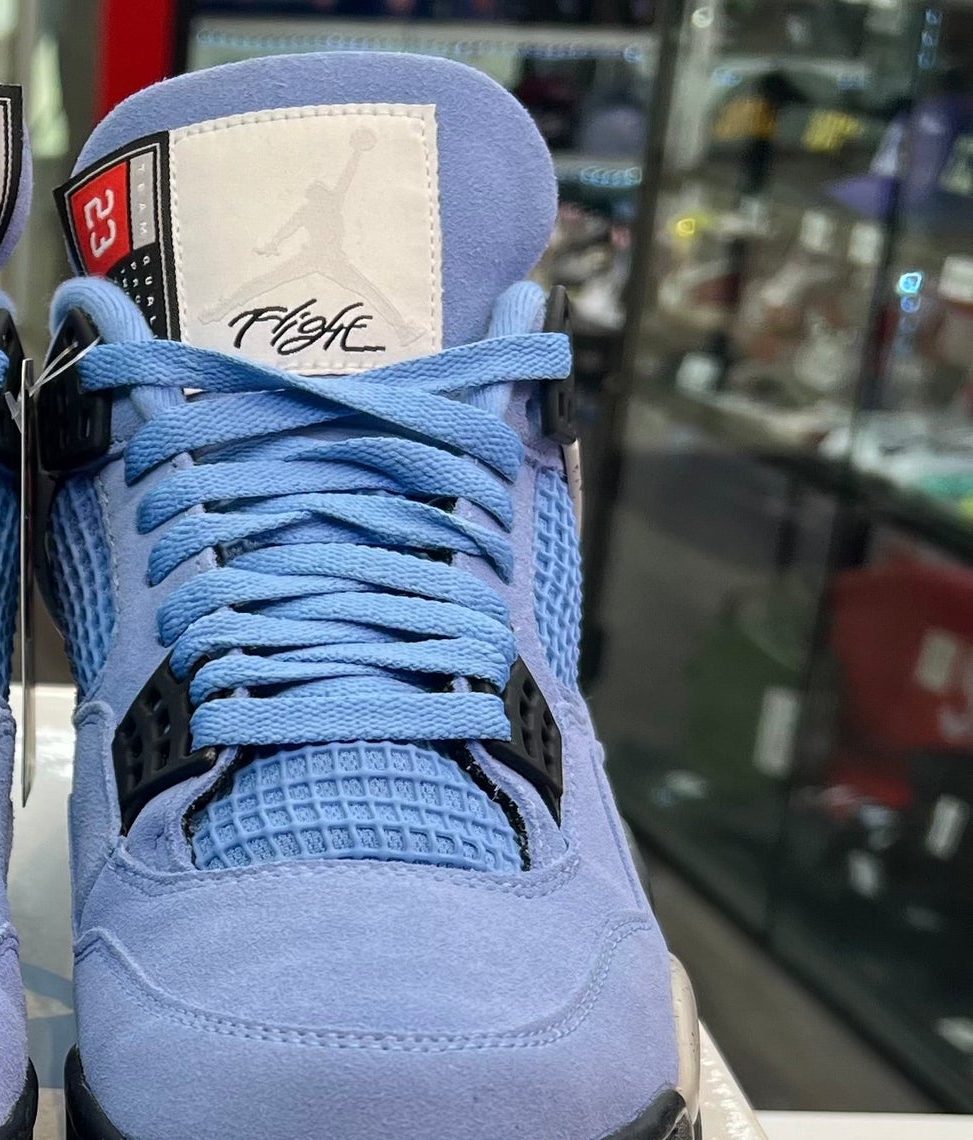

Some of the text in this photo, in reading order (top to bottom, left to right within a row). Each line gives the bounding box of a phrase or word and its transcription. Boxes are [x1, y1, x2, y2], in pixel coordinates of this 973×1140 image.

[83, 188, 117, 259] 23
[136, 162, 149, 236] TEAM
[228, 298, 386, 355] Flight
